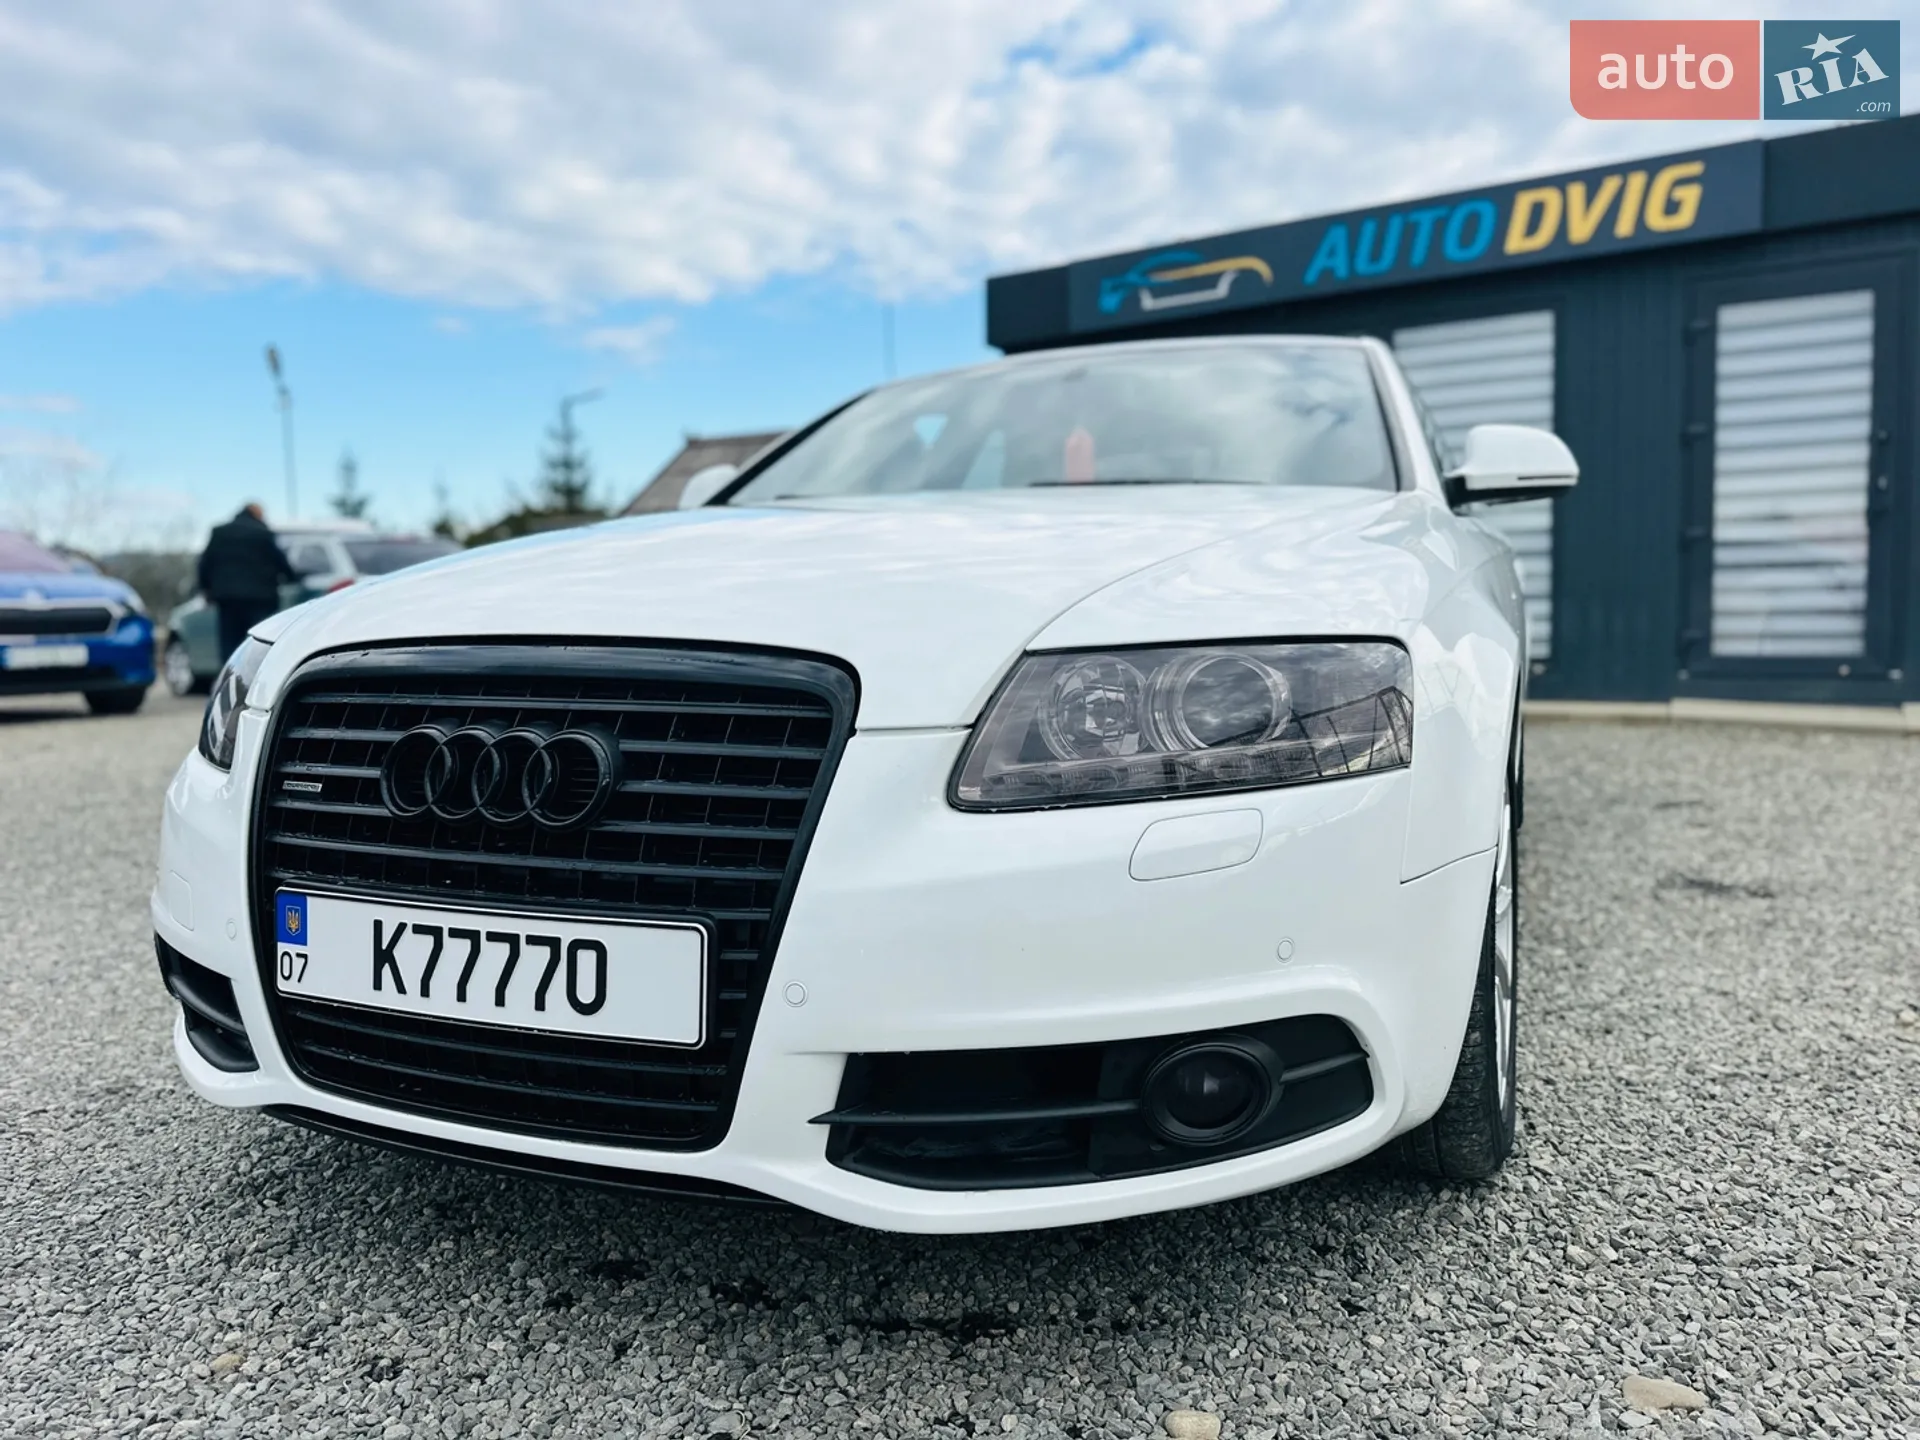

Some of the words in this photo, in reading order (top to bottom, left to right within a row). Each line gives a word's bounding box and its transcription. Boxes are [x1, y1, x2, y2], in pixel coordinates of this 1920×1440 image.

[1304, 200, 1495, 283] AUTO
[1505, 161, 1703, 254] DVIG
[280, 951, 308, 983] 07
[373, 919, 607, 1016] K77770
